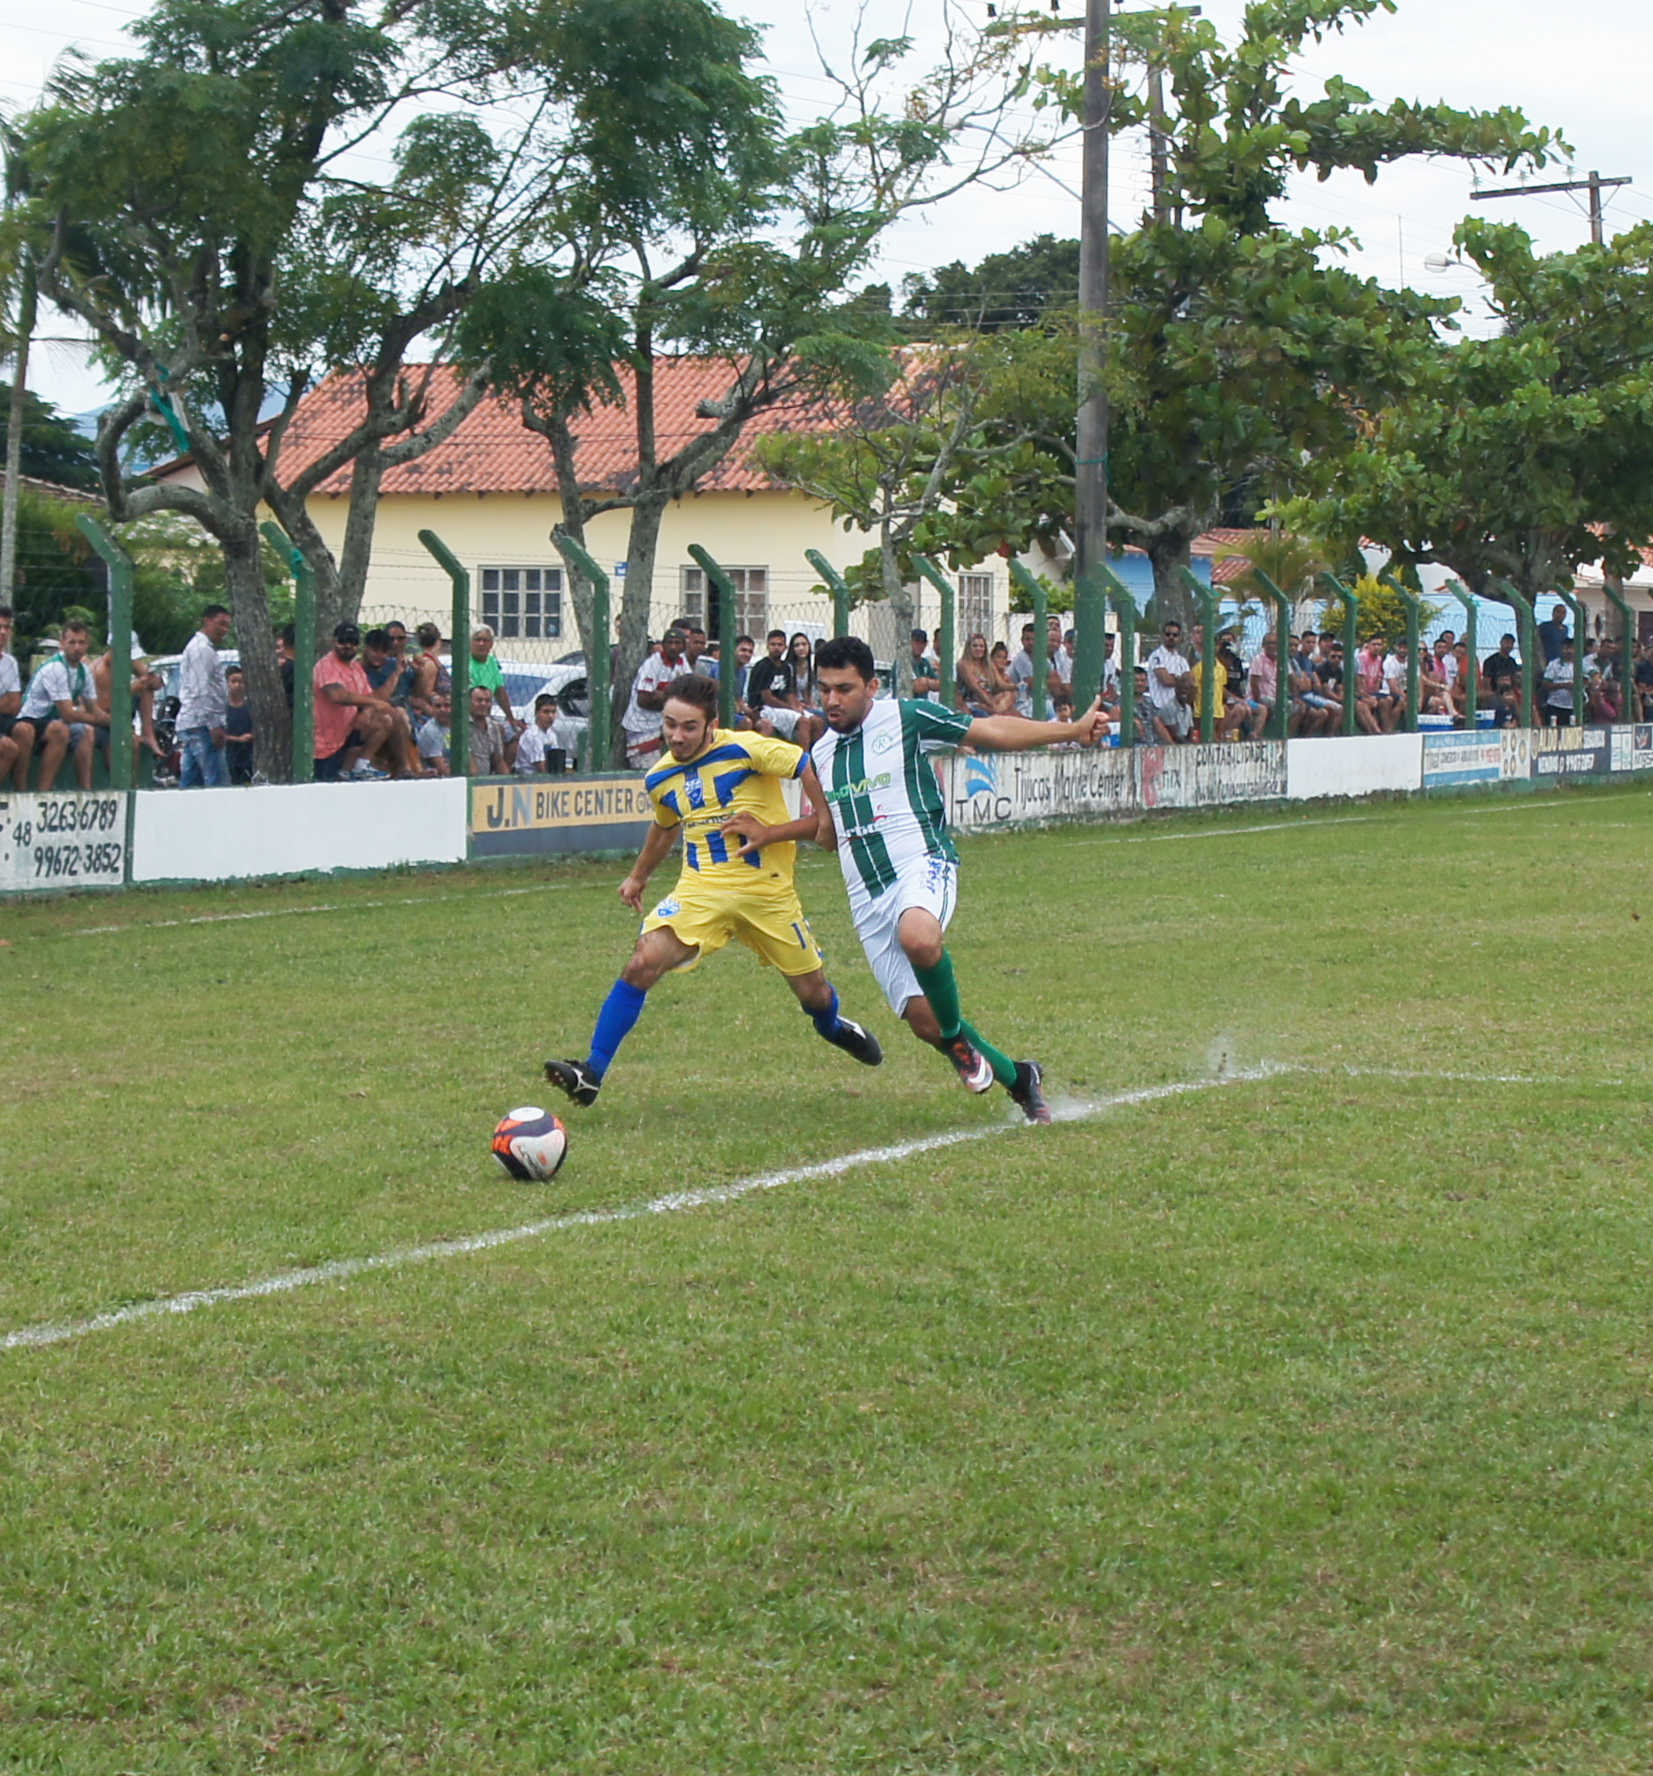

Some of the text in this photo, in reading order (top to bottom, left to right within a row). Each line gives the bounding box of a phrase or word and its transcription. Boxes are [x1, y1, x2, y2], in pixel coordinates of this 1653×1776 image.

[487, 786, 532, 828] J.N
[536, 790, 570, 819] BIKE
[574, 788, 633, 816] CENTER
[955, 797, 1012, 824] TMC
[12, 821, 32, 847] 48
